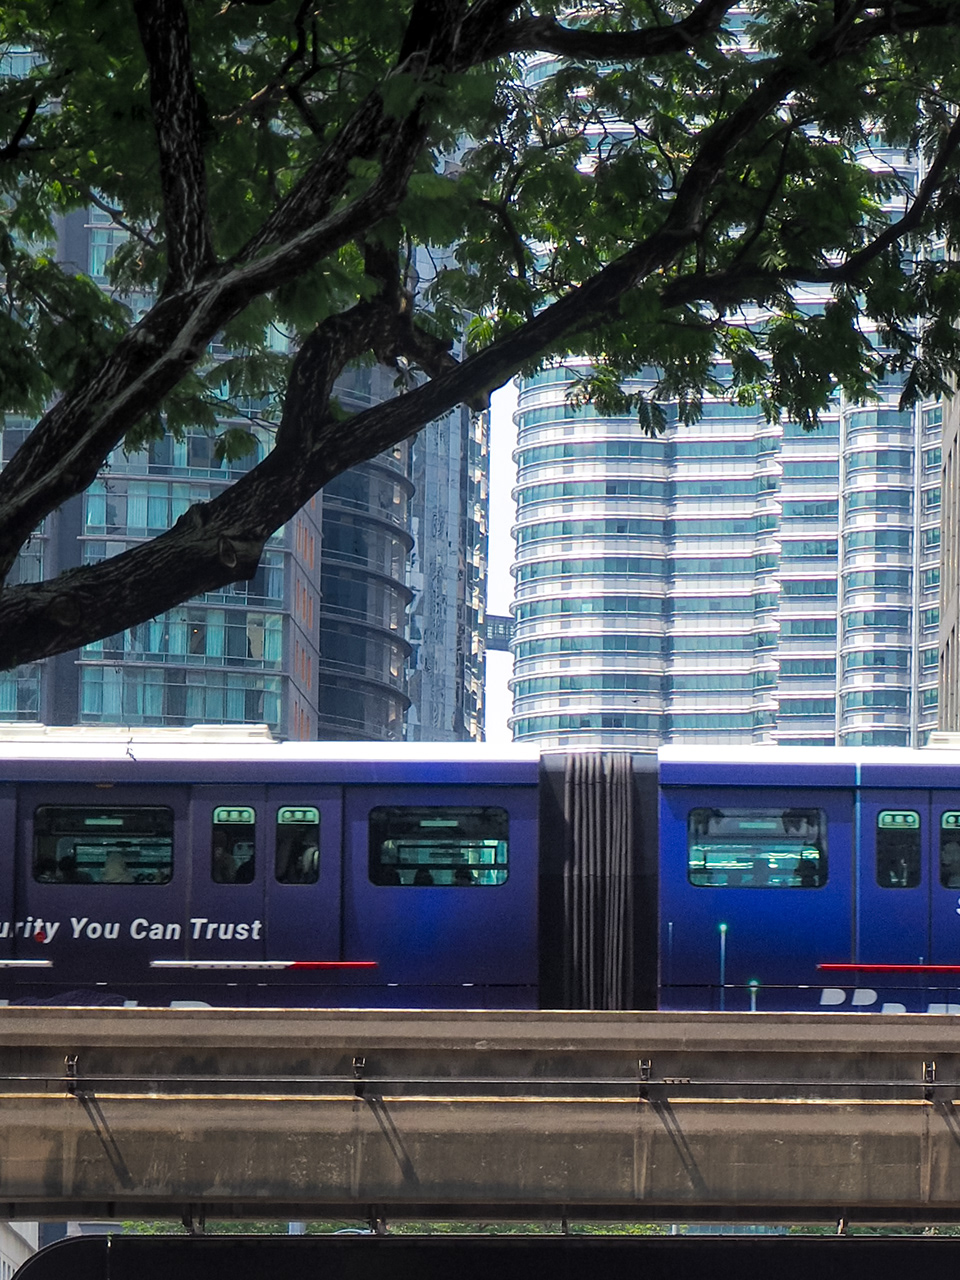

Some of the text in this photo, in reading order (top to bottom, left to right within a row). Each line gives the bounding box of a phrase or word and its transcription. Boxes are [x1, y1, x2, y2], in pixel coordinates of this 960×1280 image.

[70, 917, 121, 939] You
[130, 917, 181, 940] Can
[190, 917, 262, 940] Trust
